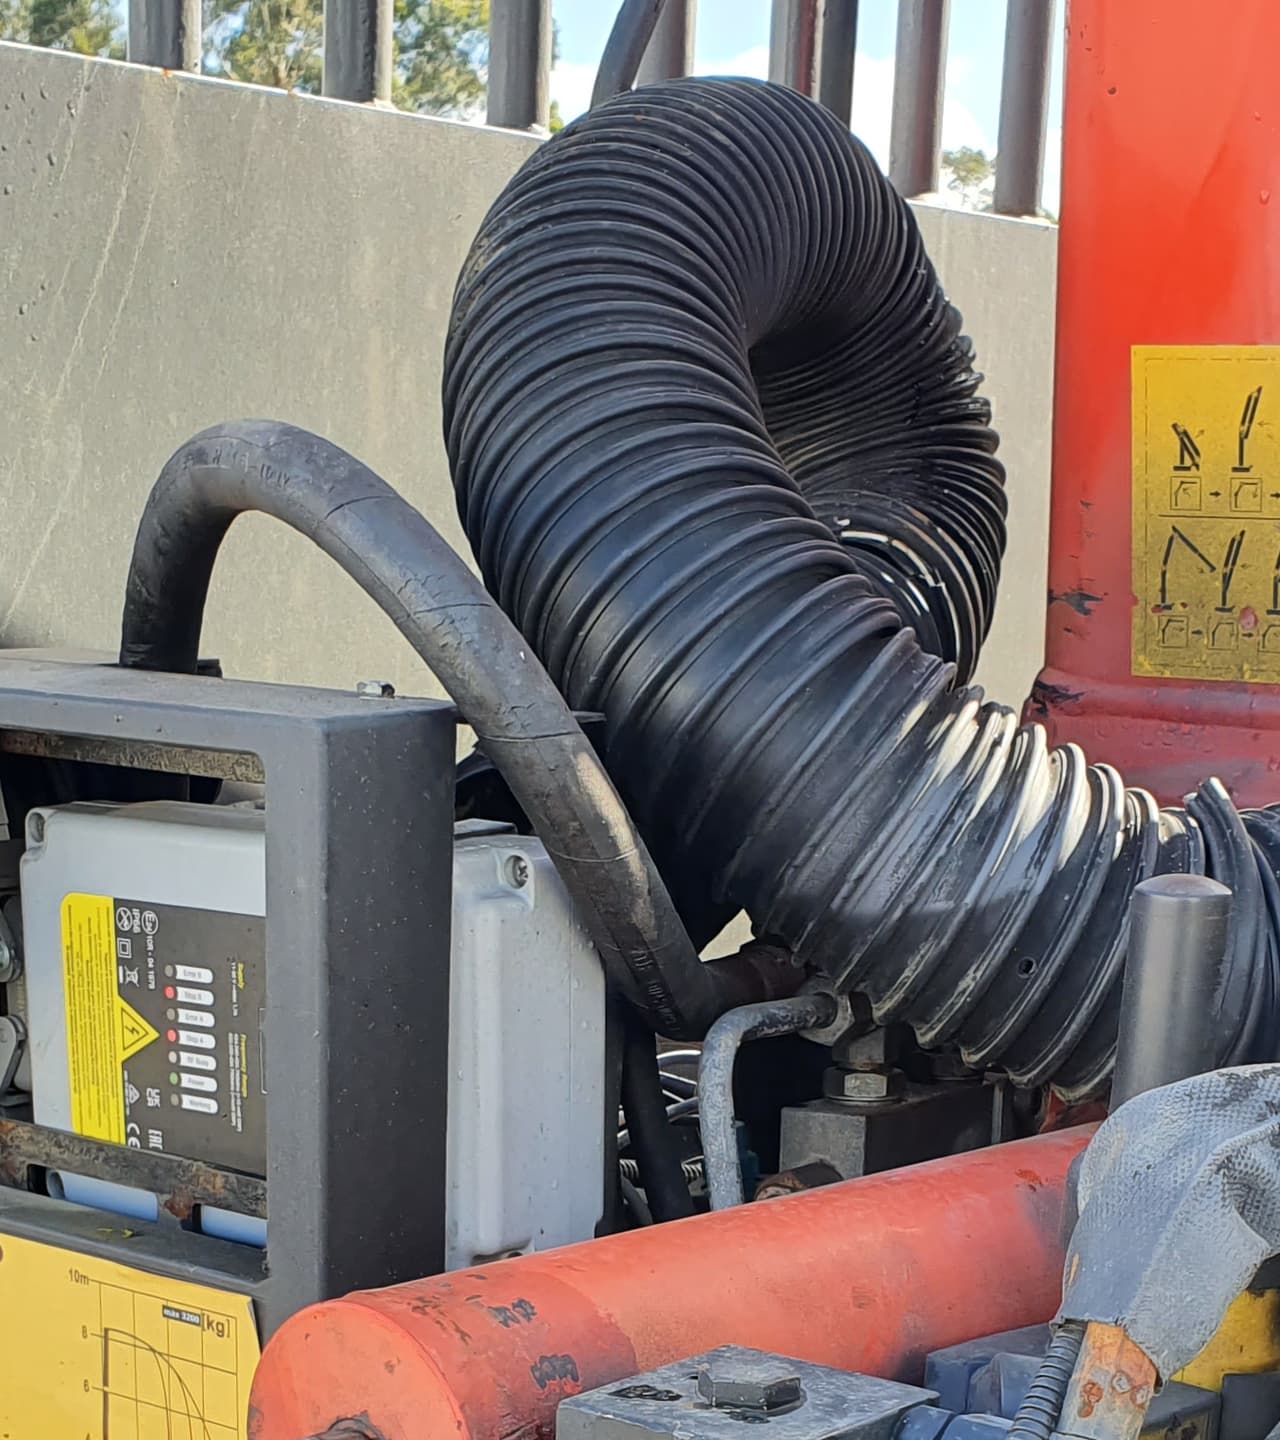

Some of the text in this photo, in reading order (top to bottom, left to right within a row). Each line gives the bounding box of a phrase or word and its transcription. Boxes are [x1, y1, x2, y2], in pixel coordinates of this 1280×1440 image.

[68, 1268, 89, 1286] 10m
[81, 1325, 89, 1339] 8
[83, 1379, 90, 1393] 6
